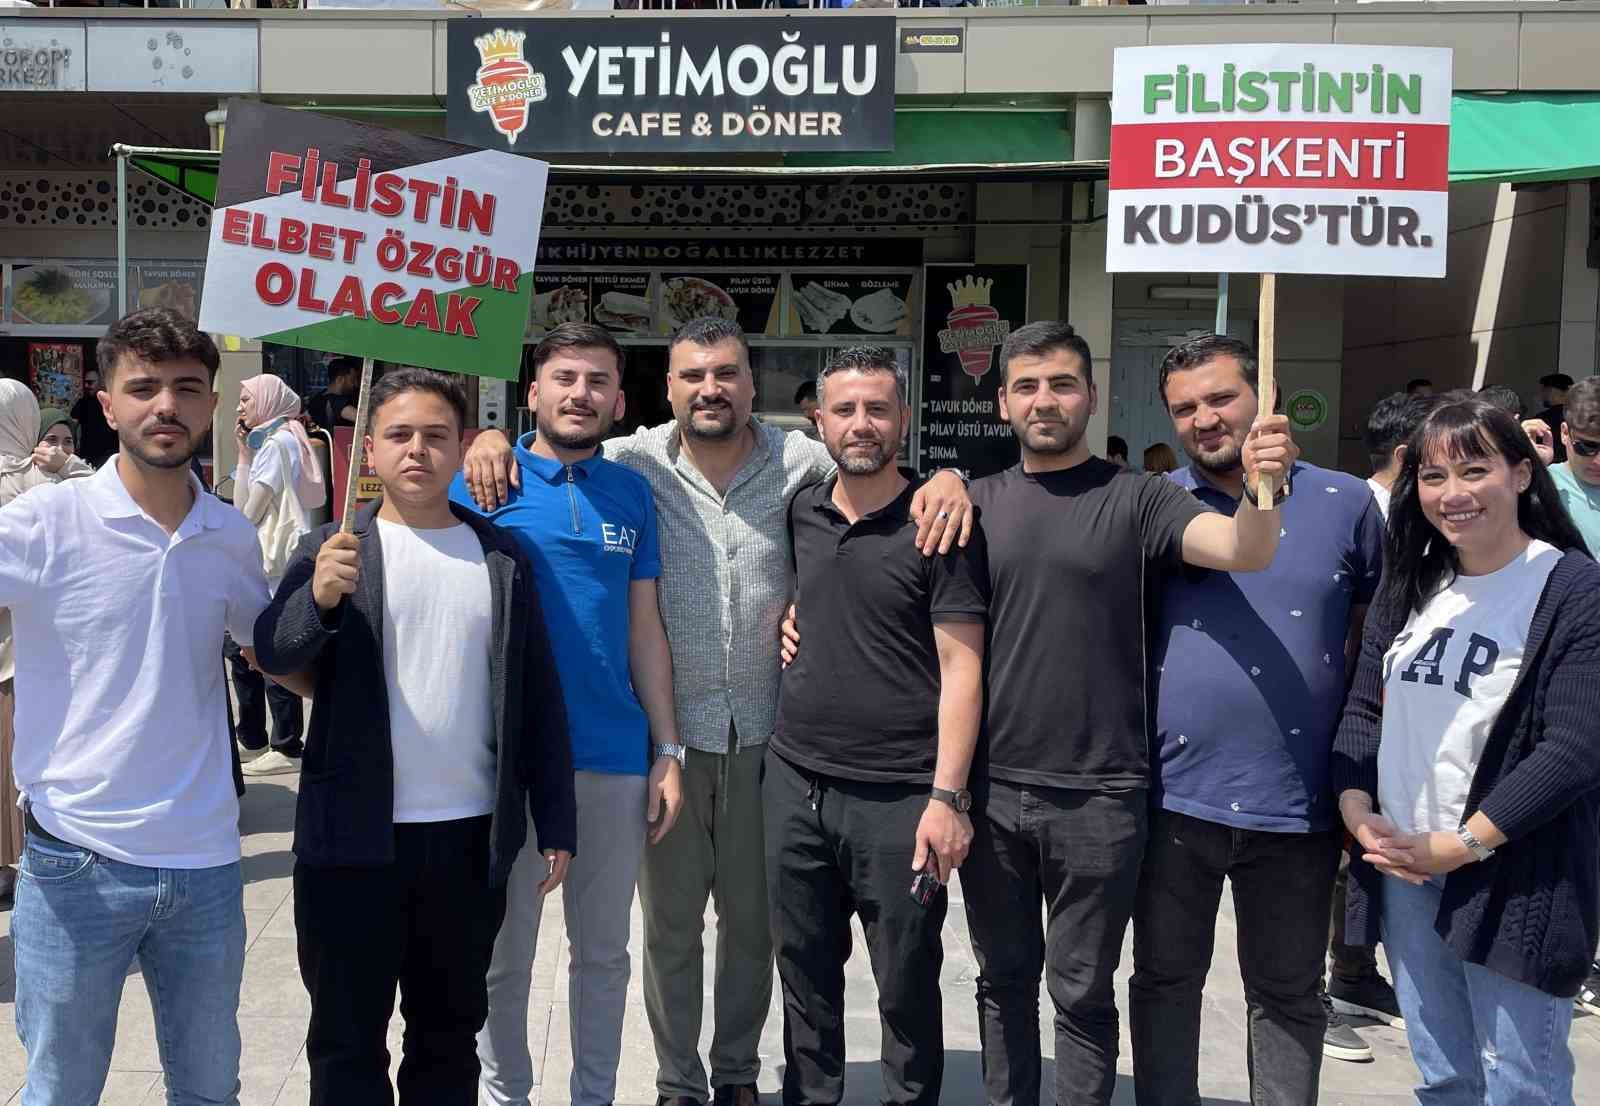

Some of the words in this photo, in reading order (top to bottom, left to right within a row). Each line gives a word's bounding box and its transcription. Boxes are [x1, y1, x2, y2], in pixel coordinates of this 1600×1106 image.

[472, 76, 542, 97] YETİMOĞLU
[561, 31, 877, 97] YETİMOĞLU
[1143, 63, 1422, 115] FİLİSTİN'İN
[592, 111, 681, 137] CAFE
[691, 111, 713, 137] &
[722, 106, 843, 137] DÖNER
[1154, 131, 1406, 184] BAŞKENTİ
[265, 147, 496, 236] FİLİSTİN
[1123, 194, 1434, 247] KUDÜS'TÜR.
[222, 207, 365, 264] ELBET
[376, 228, 521, 293] ÖZGÜR
[255, 261, 483, 338] OLACAK
[561, 274, 588, 284] DÖNER
[929, 421, 955, 437] PİLAV
[957, 421, 981, 437] ÜSTÜ
[983, 423, 1013, 437] TAVUK
[930, 400, 960, 414] TAVUK
[962, 397, 993, 414] DÖNER
[929, 446, 959, 459] SIKMA
